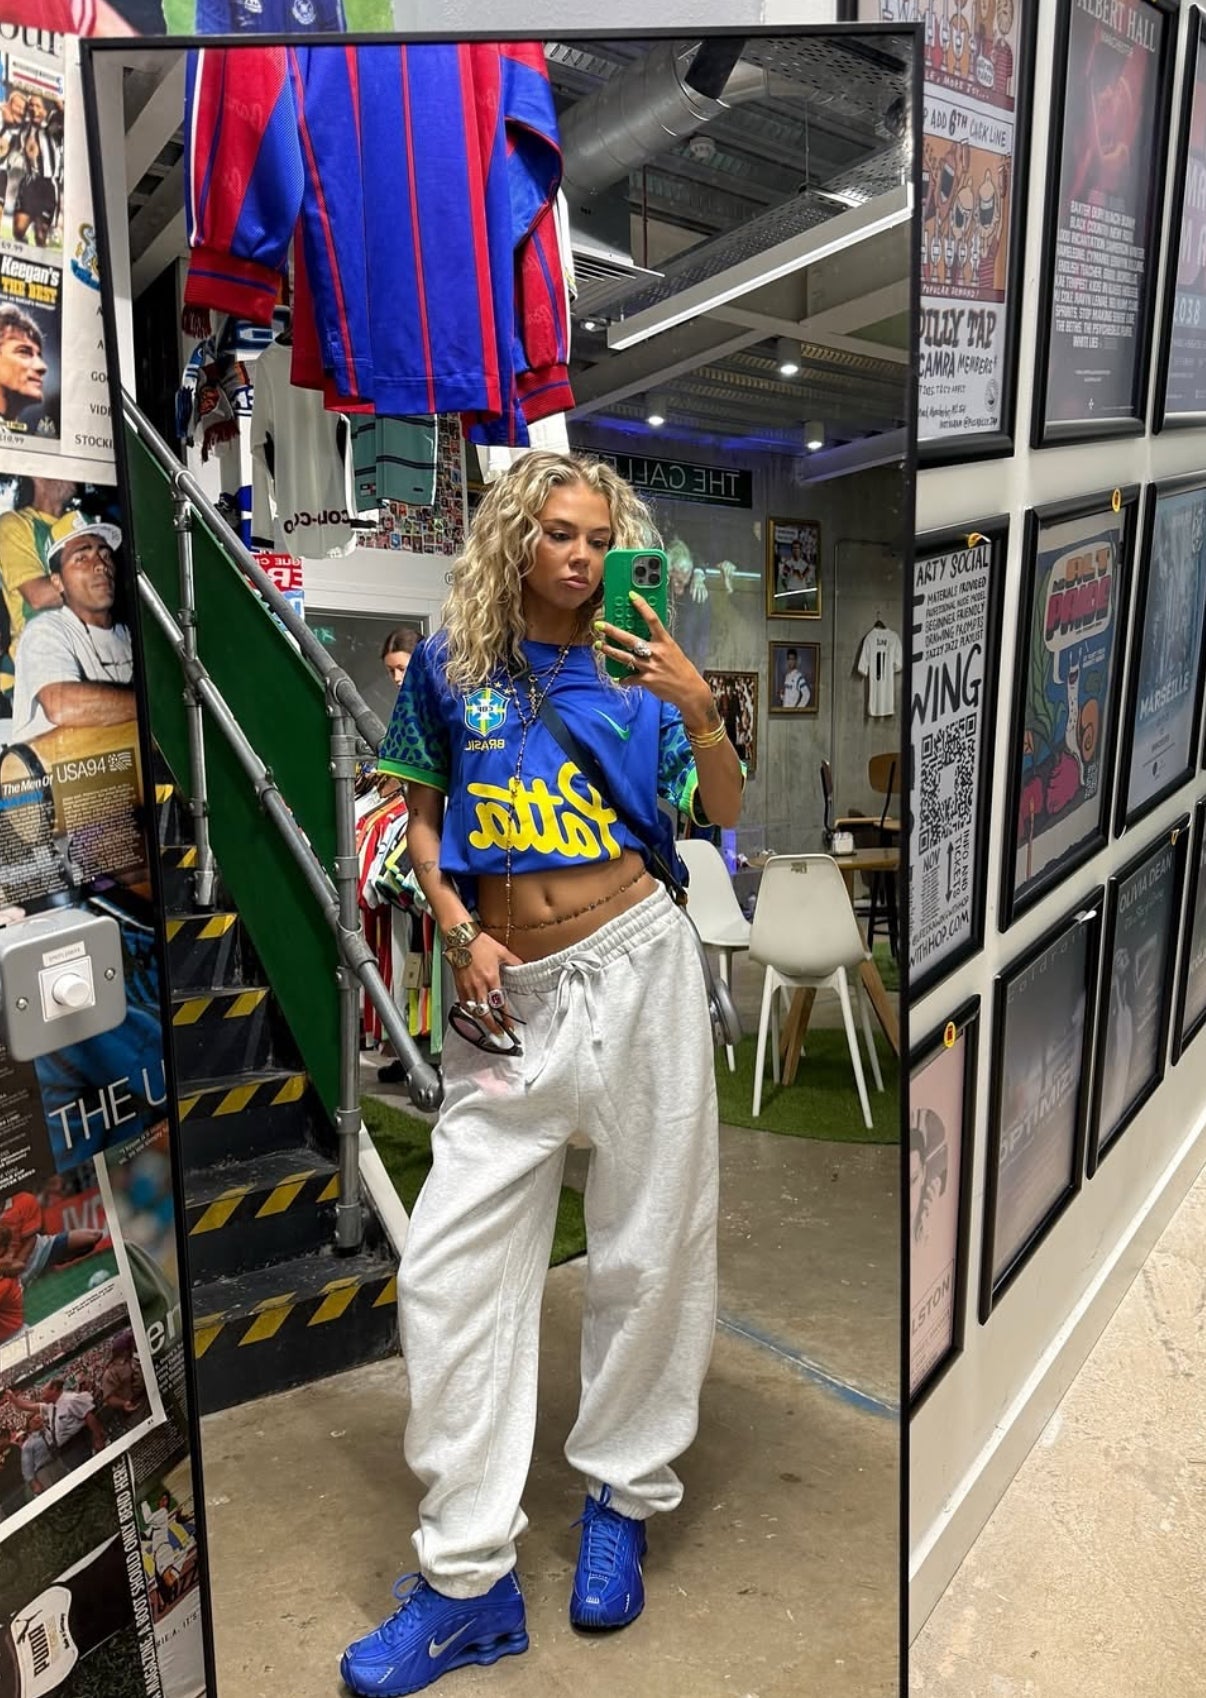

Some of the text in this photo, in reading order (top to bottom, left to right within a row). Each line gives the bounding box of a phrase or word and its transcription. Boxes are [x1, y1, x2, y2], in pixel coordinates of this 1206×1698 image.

[1126, 8, 1156, 53] HALL
[930, 109, 947, 129] ADD
[949, 108, 968, 136] 6TH
[990, 126, 1007, 148] LINE
[1, 255, 60, 286] Keegan's
[1, 275, 26, 297] THE
[28, 282, 57, 305] BEST
[922, 283, 949, 296] POPULAR
[967, 308, 997, 350] TAP
[917, 350, 955, 379] CAMRA
[916, 545, 989, 587] ARTY SOCIAL
[927, 585, 958, 606] MATERIALS
[925, 602, 985, 634] BEGINNER FRIENDLY
[925, 615, 984, 648] DRAWING PROMPTS
[959, 629, 984, 648] PLAYLIST
[1139, 670, 1190, 721] MARSEILLE
[2, 780, 22, 796] The
[21, 778, 42, 792] Men
[56, 757, 107, 784] USA94
[923, 847, 941, 873] NOV
[961, 829, 970, 860] INFO
[952, 834, 962, 899] TICKETS
[1119, 874, 1148, 914] OLIVIA
[1148, 851, 1173, 888] DEAN
[48, 1076, 137, 1150] THE
[116, 1490, 134, 1525] BEND
[120, 1524, 139, 1553] ONLY
[125, 1550, 147, 1597] SHOULD
[131, 1593, 149, 1626] BOOT
[28, 1623, 51, 1678] PUMA
